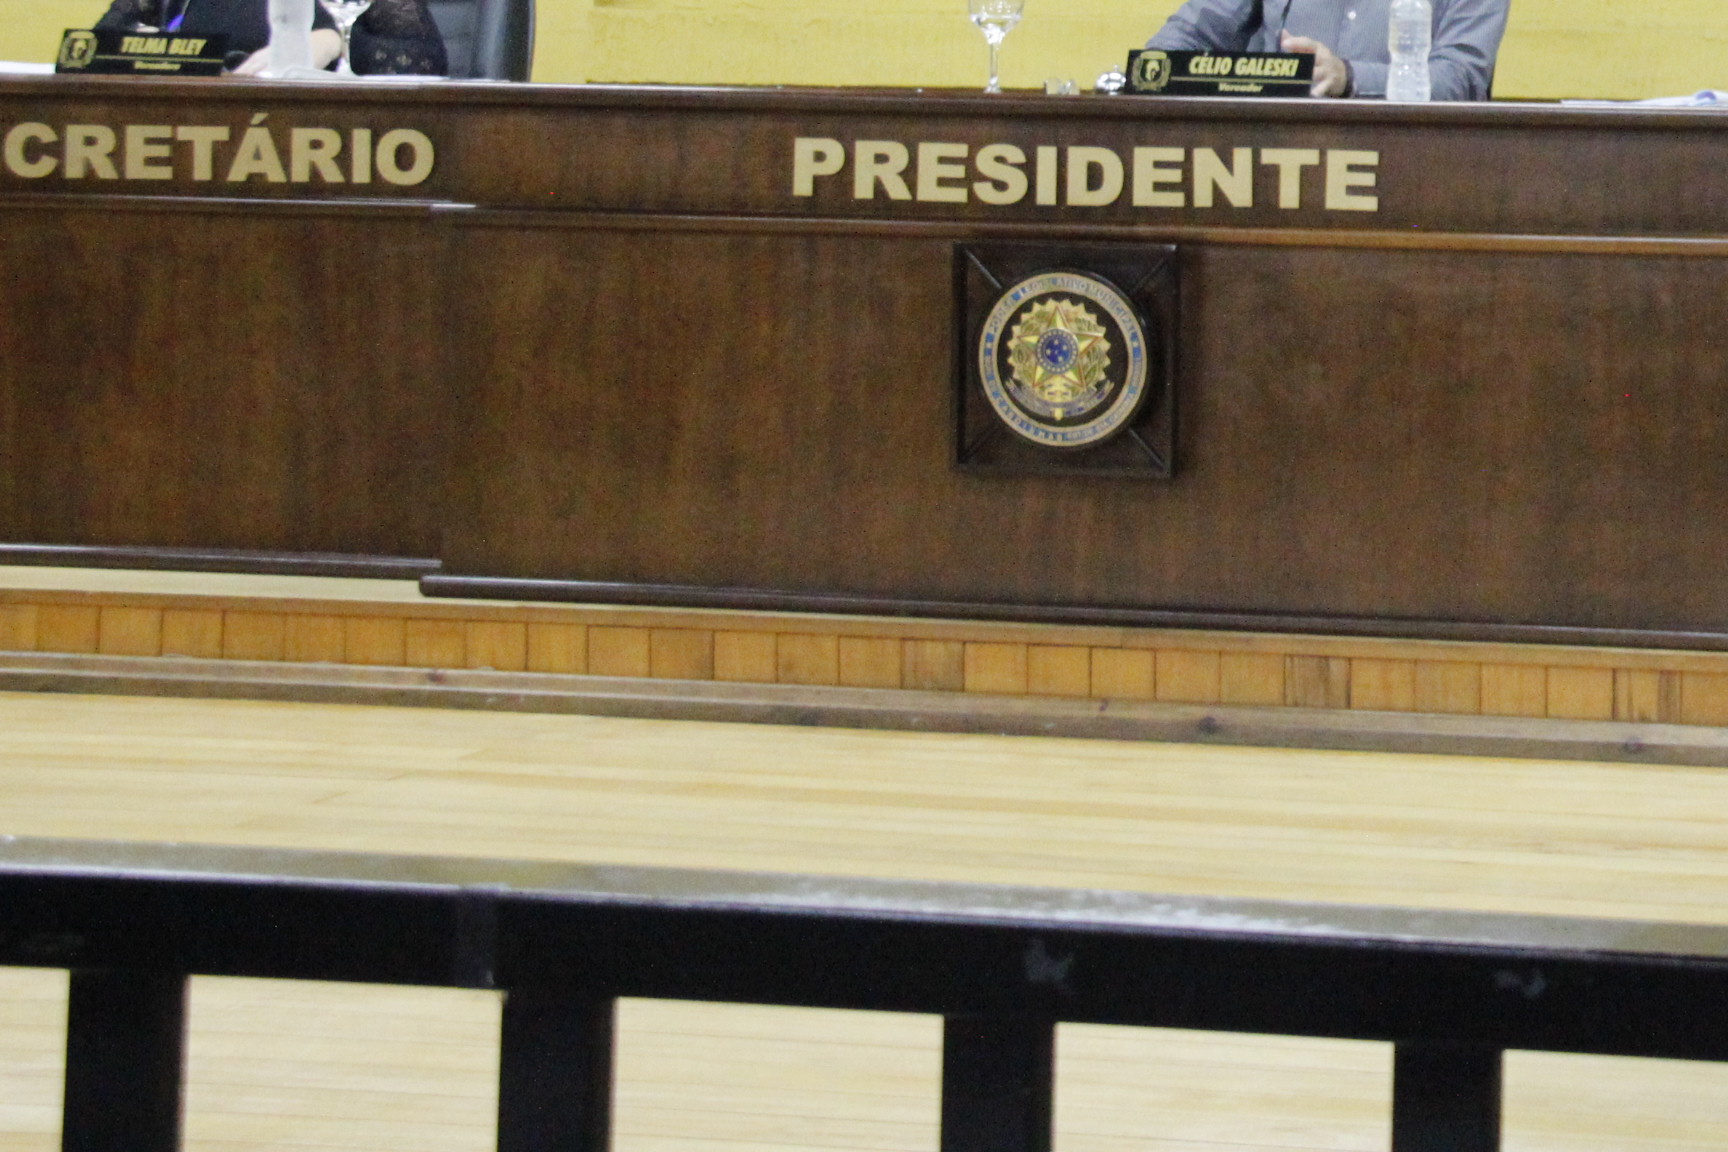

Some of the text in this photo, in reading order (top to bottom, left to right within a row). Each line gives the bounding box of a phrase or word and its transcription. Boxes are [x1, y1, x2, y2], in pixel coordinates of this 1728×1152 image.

[121, 36, 168, 54] TELMA
[1189, 52, 1300, 77] CÉLIO GALESKI
[4, 113, 436, 185] CRETÁRIO
[792, 137, 1380, 212] PRESIDENTE
